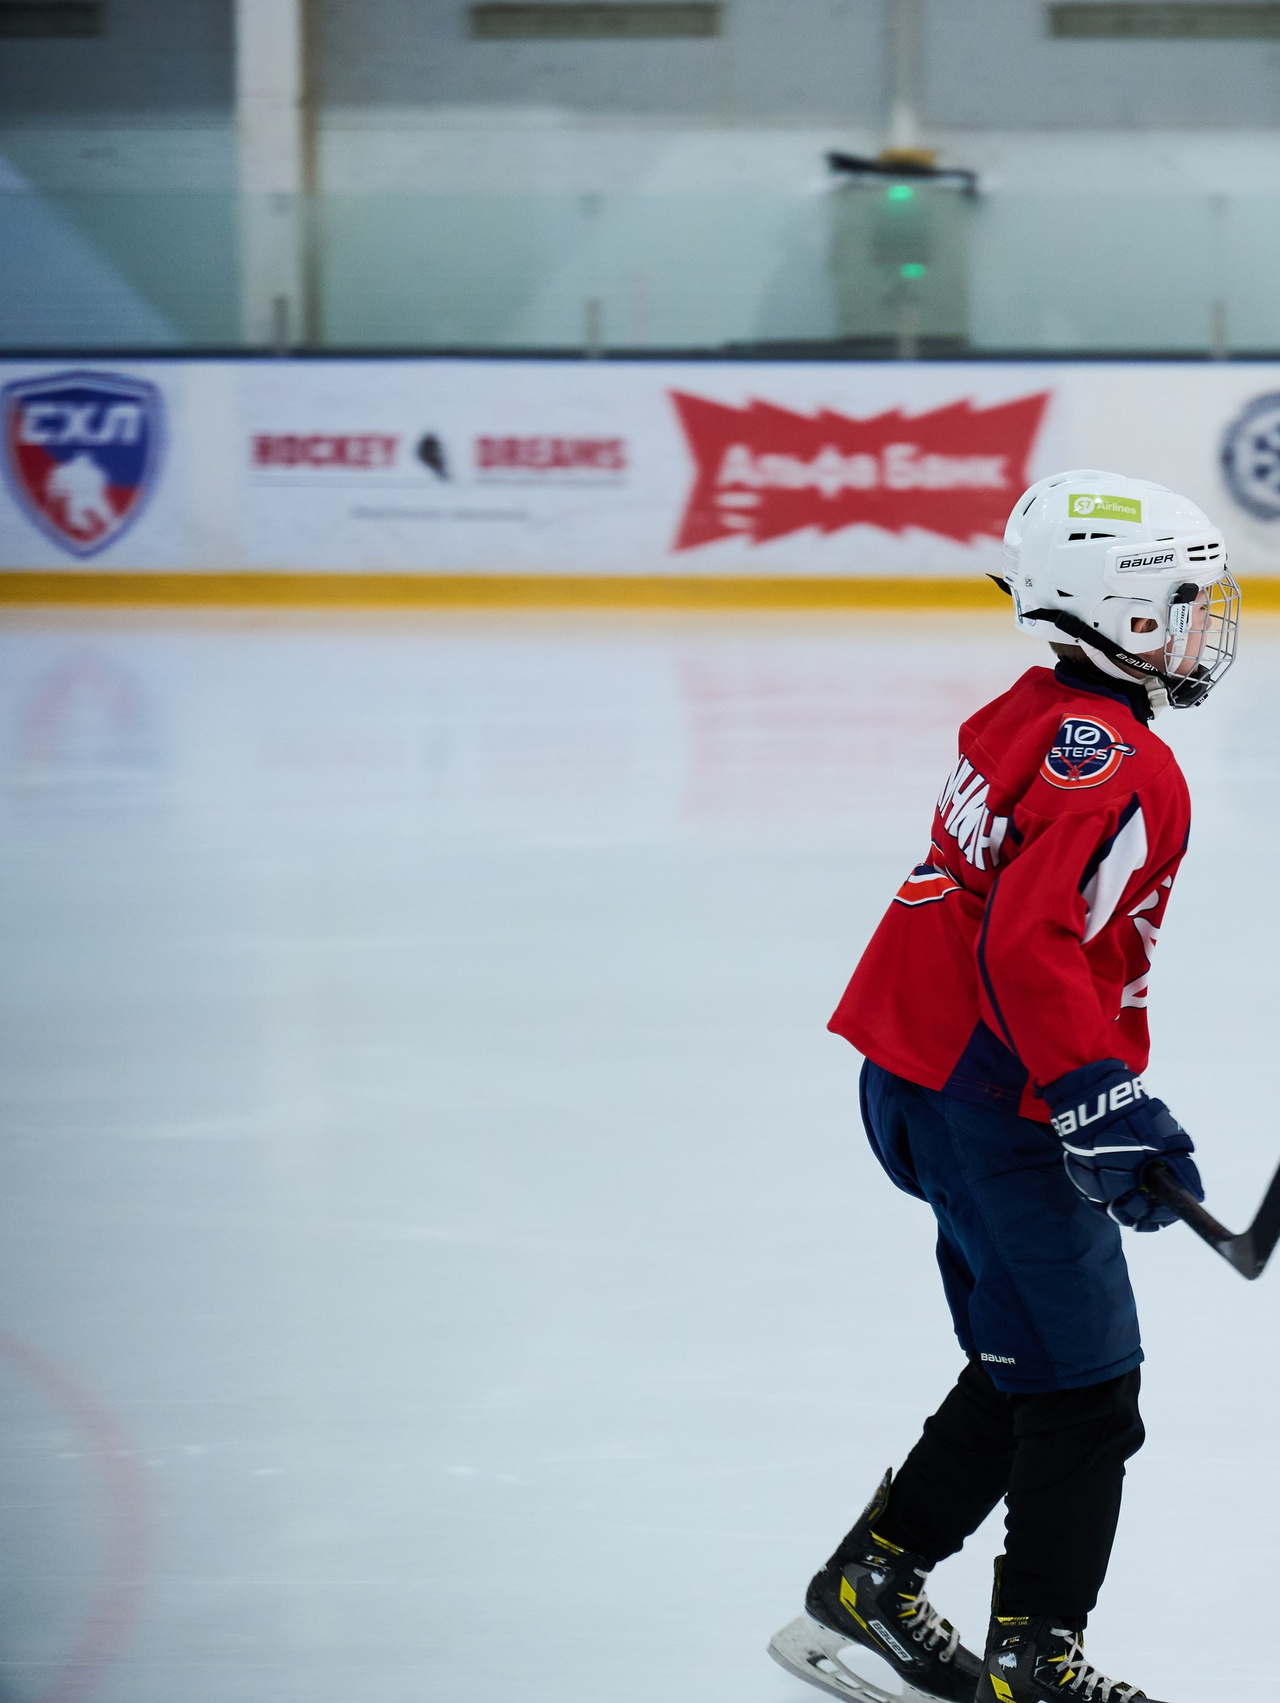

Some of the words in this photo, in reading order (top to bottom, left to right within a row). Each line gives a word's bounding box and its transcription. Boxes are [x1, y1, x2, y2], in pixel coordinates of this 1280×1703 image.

[251, 434, 398, 470] HOCKEY
[474, 436, 628, 472] DREAMS
[1097, 501, 1137, 515] Airlines
[1064, 724, 1101, 745] 10
[1050, 747, 1108, 760] STEPS
